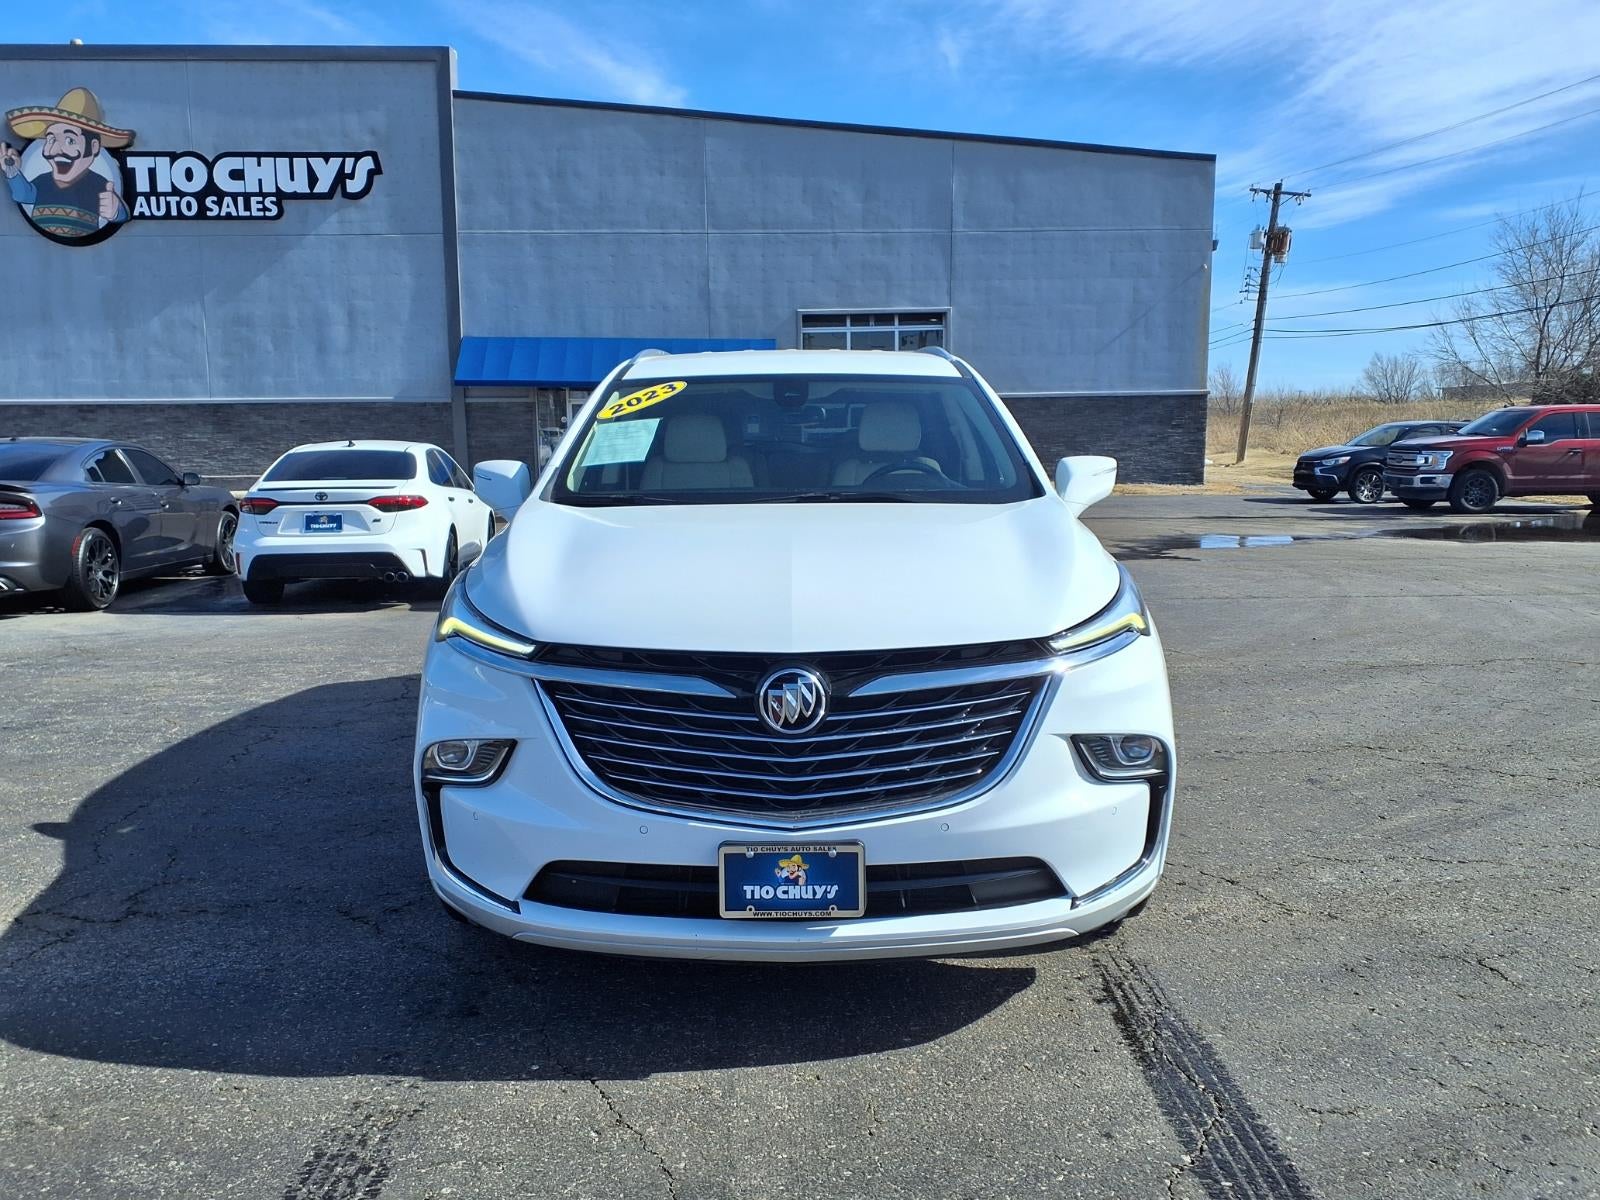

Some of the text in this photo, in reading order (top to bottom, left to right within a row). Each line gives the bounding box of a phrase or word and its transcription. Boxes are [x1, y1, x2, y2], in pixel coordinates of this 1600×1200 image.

[127, 155, 376, 193] TIO CHUY'S
[133, 196, 279, 217] AUTO SALES
[609, 383, 678, 416] 2023
[743, 884, 839, 900] TIO CHUY'S
